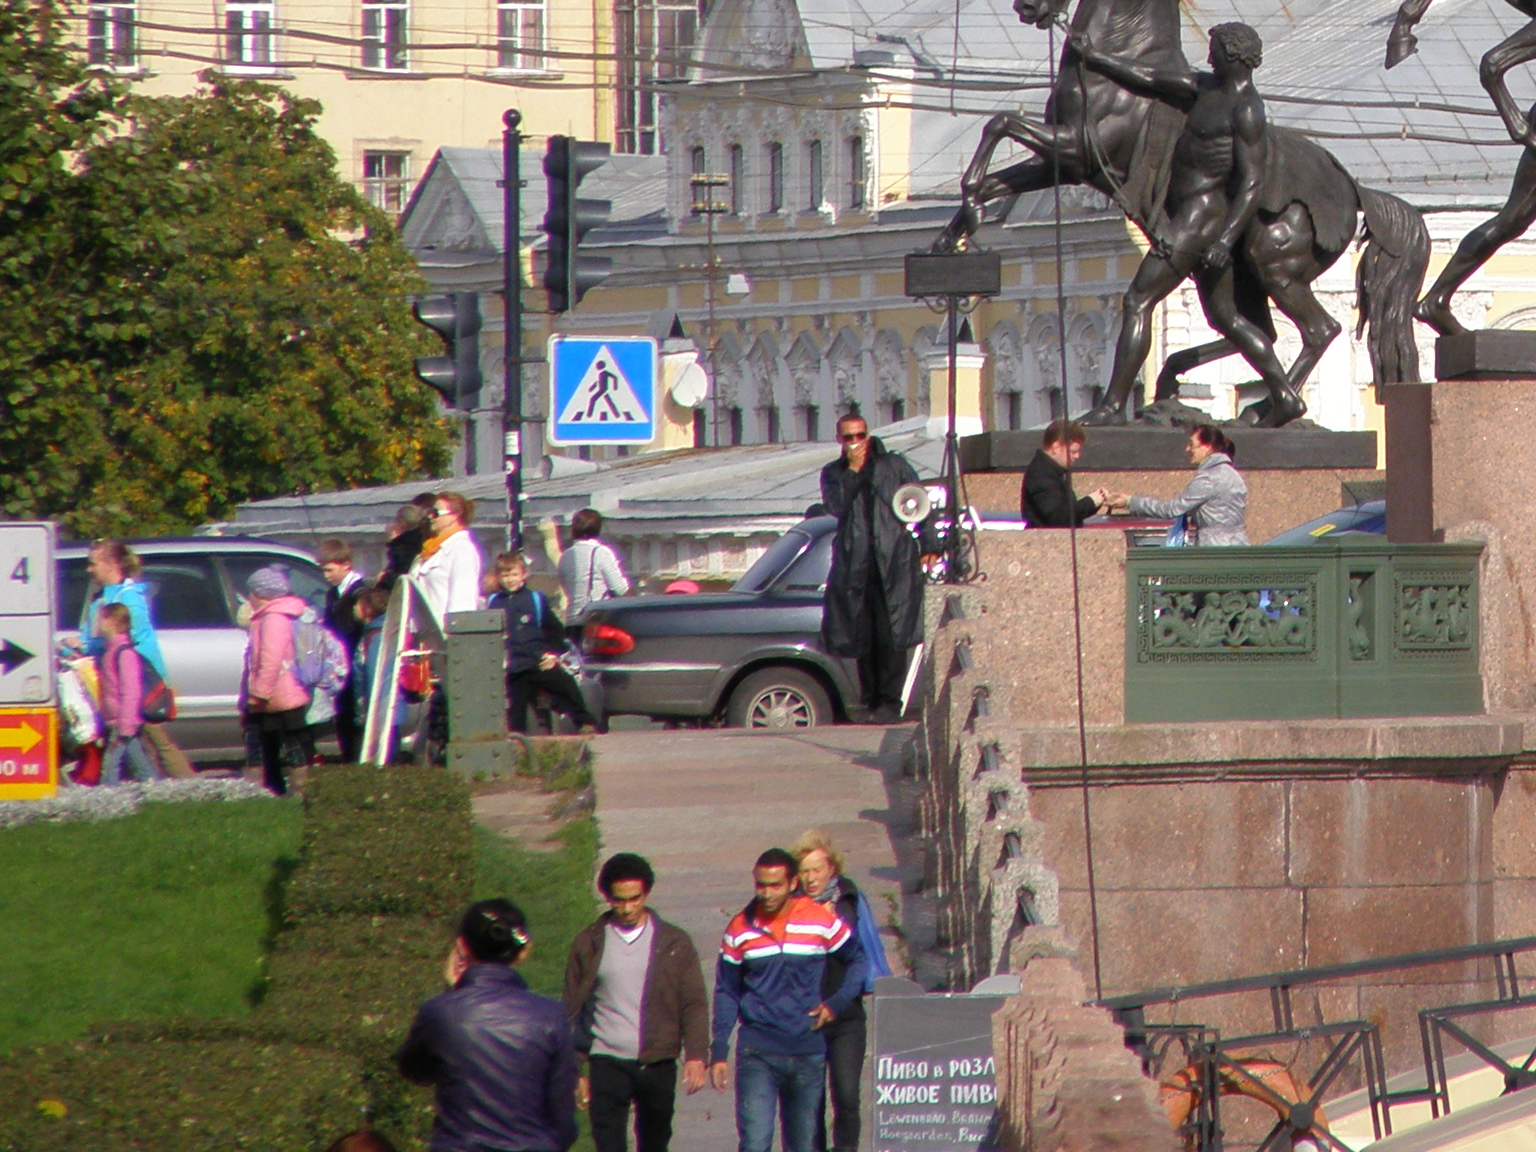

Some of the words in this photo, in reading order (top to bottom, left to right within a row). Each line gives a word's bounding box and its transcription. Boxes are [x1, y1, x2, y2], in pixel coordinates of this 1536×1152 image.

[10, 556, 30, 584] 4
[0, 760, 16, 776] 0
[876, 1084, 940, 1105] ЖИВОЕ
[950, 1084, 997, 1104] ПИВ
